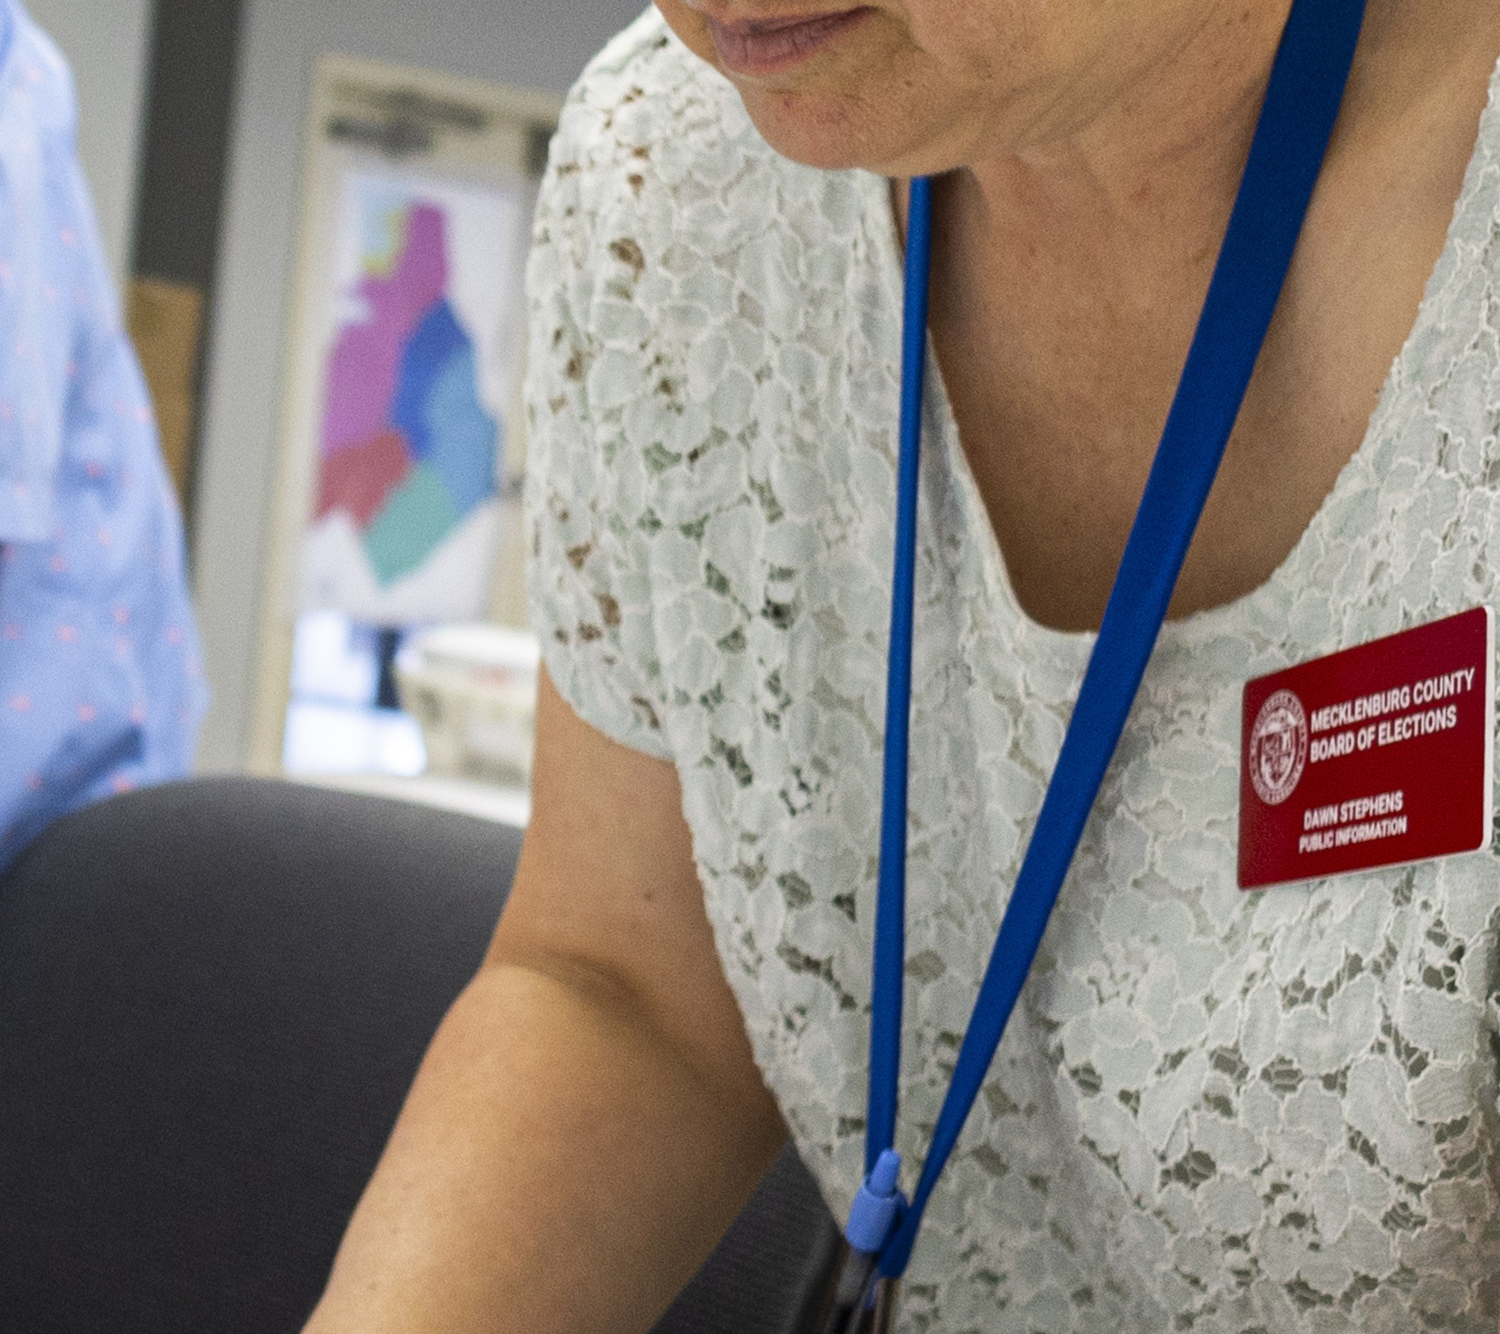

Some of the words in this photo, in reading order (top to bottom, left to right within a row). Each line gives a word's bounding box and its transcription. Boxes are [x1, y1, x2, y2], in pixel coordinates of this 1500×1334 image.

[1310, 684, 1410, 733] MECKLENBURG
[1413, 667, 1476, 705] COUNTY
[1310, 731, 1354, 764] BOARD
[1357, 724, 1376, 751] OF
[1378, 704, 1457, 747] ELECTIONS
[1298, 830, 1333, 854] PUBLIC
[1335, 815, 1407, 846] INFORMATION
[1303, 804, 1338, 831] DAWN
[1340, 790, 1404, 822] STEPHENS
